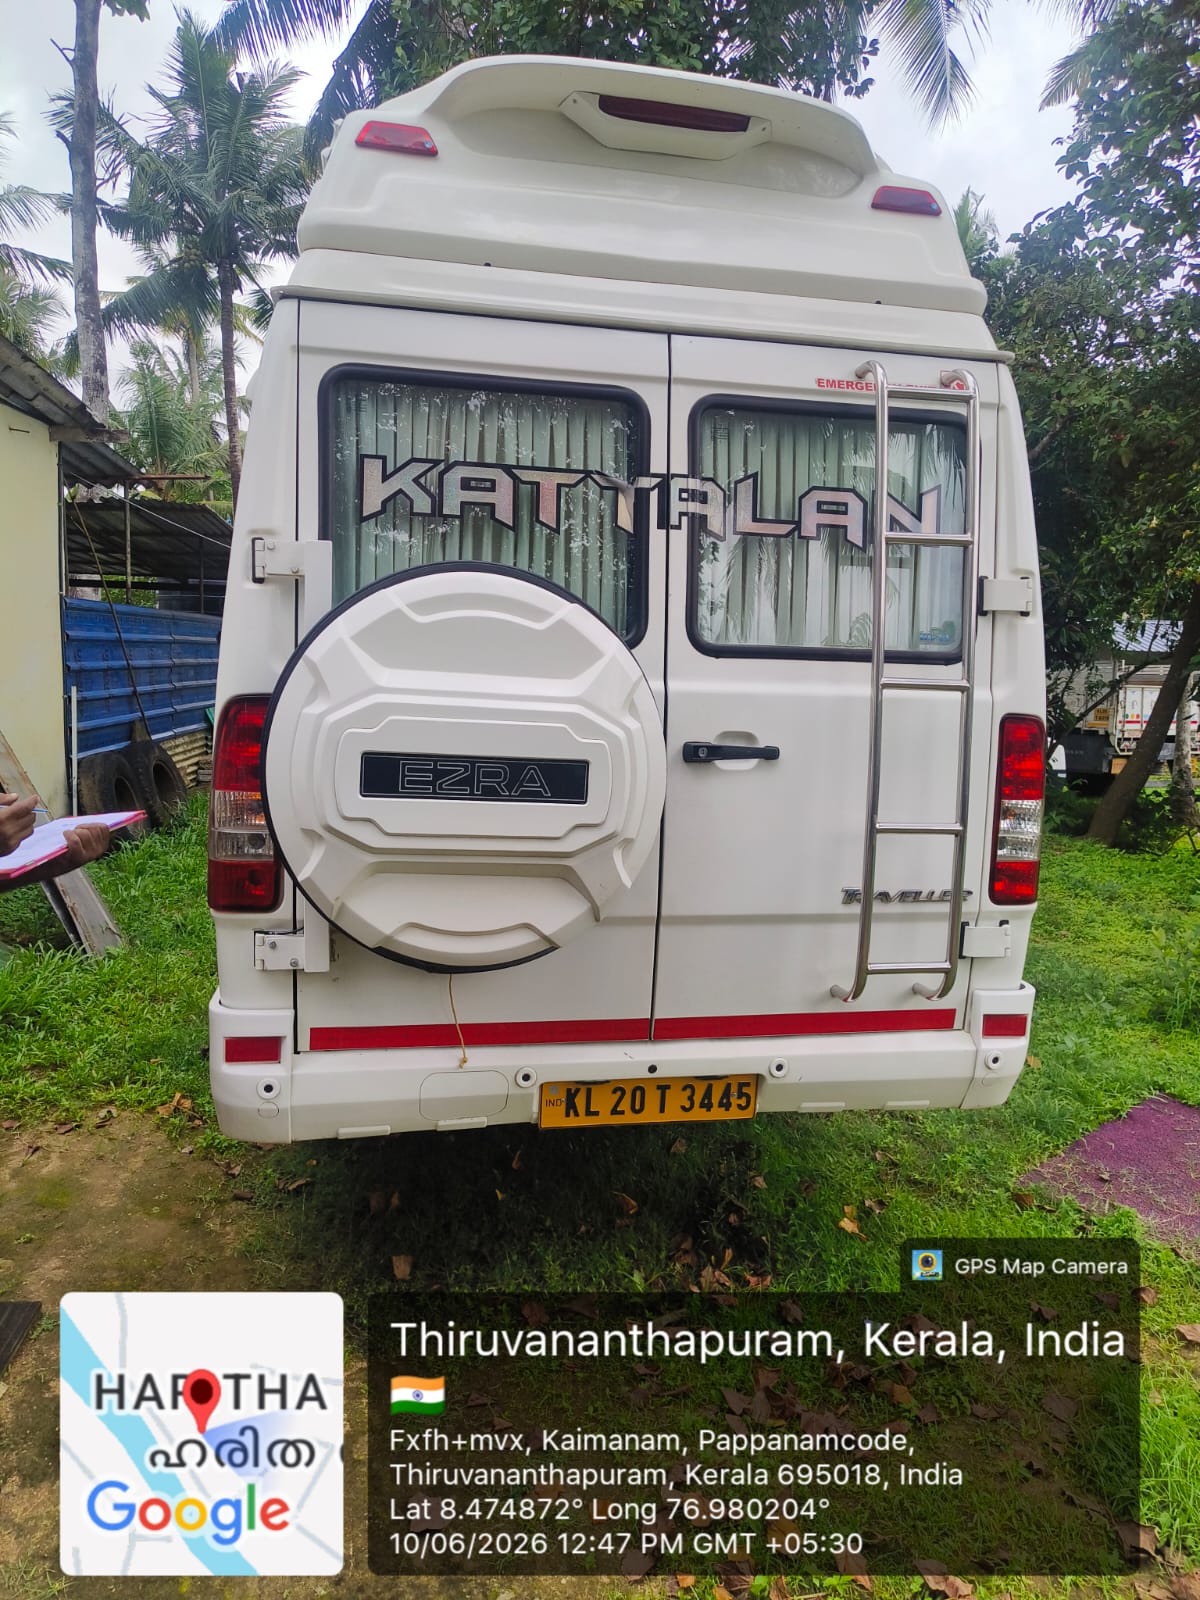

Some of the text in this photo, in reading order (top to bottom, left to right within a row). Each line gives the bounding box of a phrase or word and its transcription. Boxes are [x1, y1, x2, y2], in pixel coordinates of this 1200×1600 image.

[817, 378, 904, 392] EMERGE
[399, 760, 552, 797] EZRA
[564, 1087, 600, 1118] KL
[609, 1085, 646, 1116] 20
[656, 1084, 671, 1114] T
[679, 1081, 752, 1113] 3445
